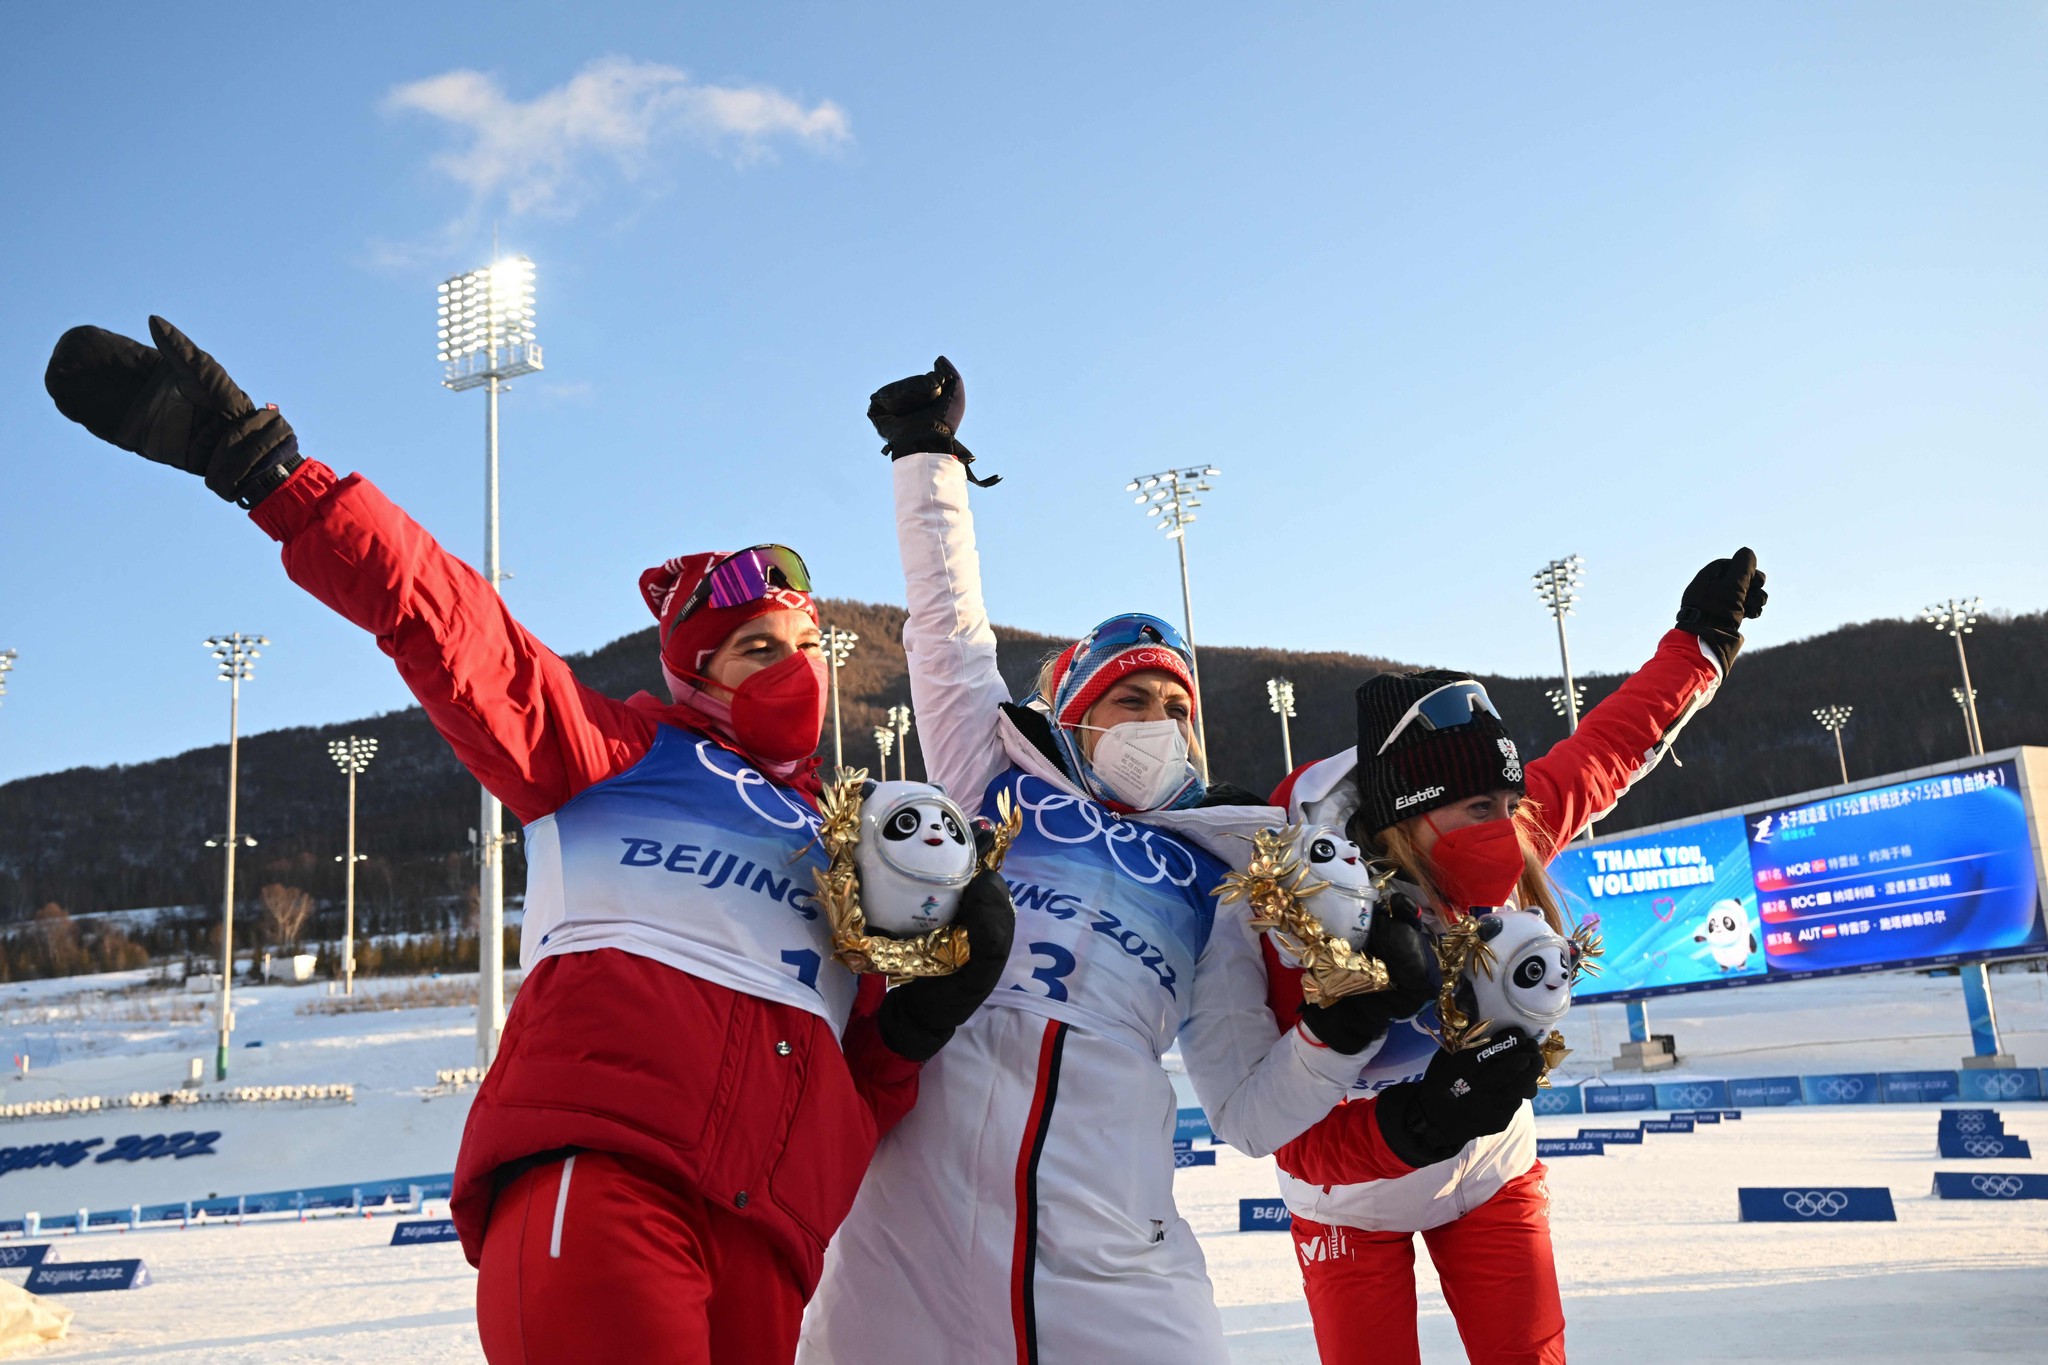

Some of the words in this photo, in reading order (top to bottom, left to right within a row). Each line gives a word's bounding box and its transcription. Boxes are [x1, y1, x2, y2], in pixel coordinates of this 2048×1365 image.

[1395, 786, 1445, 810] Eisbär
[1592, 847, 1664, 873] THANK
[1662, 845, 1707, 867] YOU,
[1785, 861, 1812, 878] NOR
[620, 837, 819, 921] BEIJING
[1587, 864, 1715, 898] VOLUNTEERS!
[1790, 894, 1817, 910] ROC
[1798, 925, 1822, 942] AUT
[1090, 909, 1176, 1002] 2022
[780, 948, 822, 990] 1
[1010, 941, 1077, 1003] 3
[1476, 1034, 1518, 1063] reusch
[1736, 1087, 1767, 1097] BEIJING
[1537, 1142, 1566, 1153] EIJING
[1568, 1142, 1596, 1151] 2022
[36, 1268, 86, 1286] BEIJING
[86, 1267, 124, 1281] 2022
